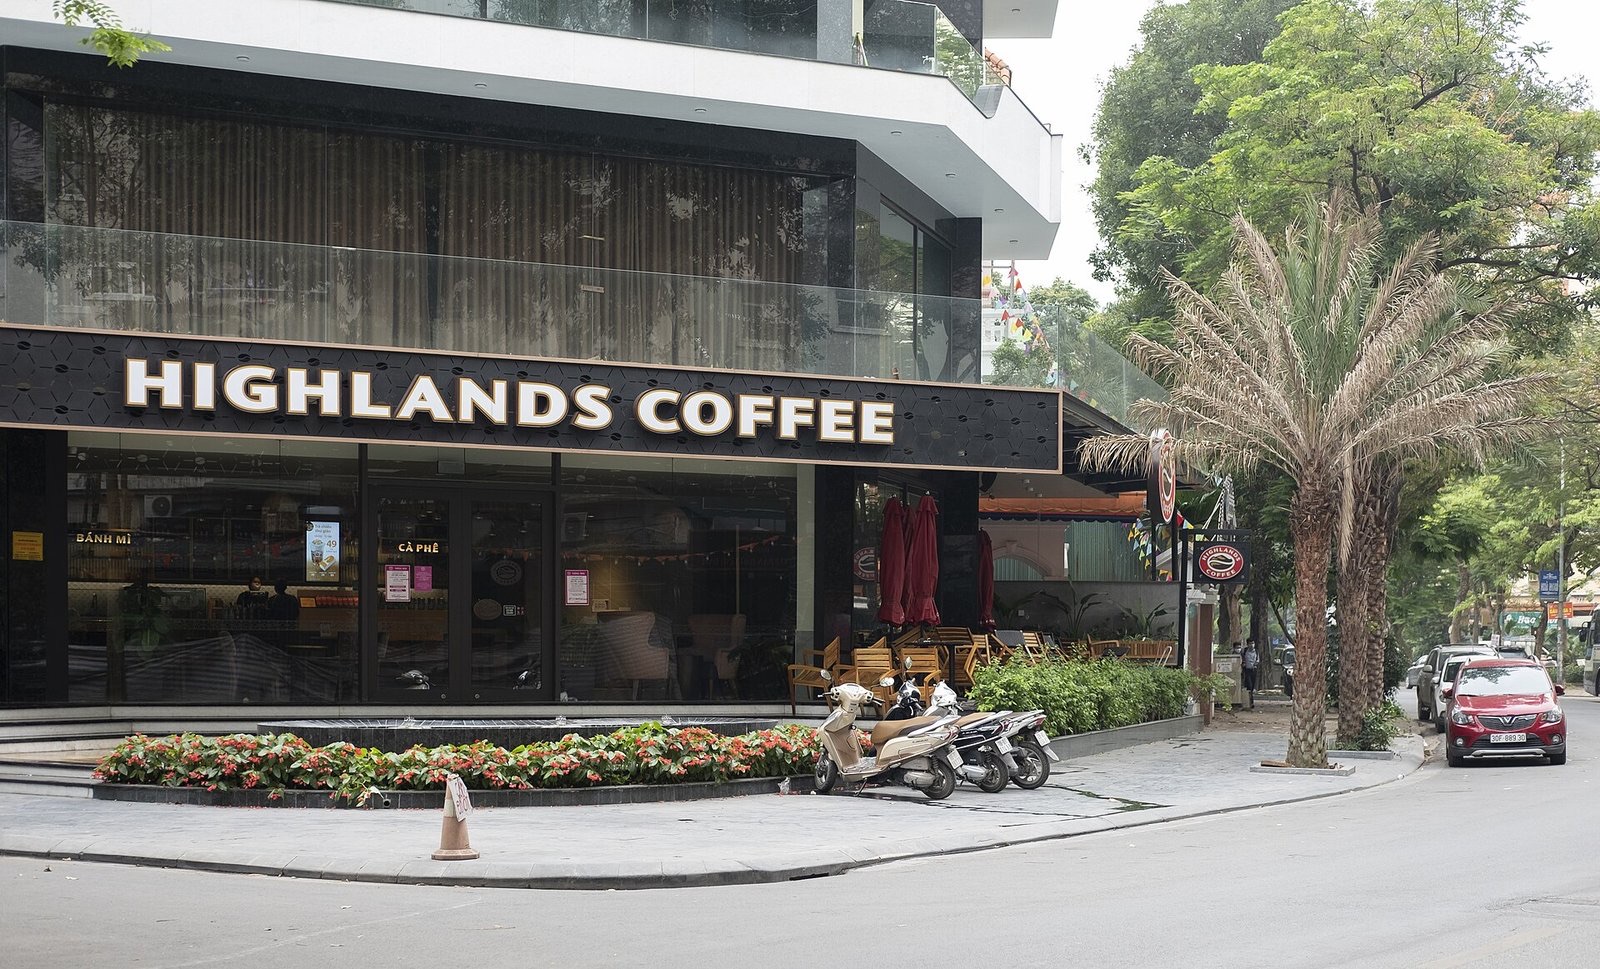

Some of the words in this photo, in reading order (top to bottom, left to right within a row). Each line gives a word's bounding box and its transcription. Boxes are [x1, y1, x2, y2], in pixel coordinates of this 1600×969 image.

[124, 358, 613, 432] HIGHLANDS
[634, 387, 896, 445] COFFEE
[76, 531, 112, 543] BÁNH
[116, 533, 131, 544] MÌ
[326, 540, 337, 548] 49
[398, 541, 414, 552] CÀ
[416, 542, 439, 553] PHÊ
[1202, 547, 1241, 562] HIGHLANDS
[1206, 569, 1236, 578] COFFEE
